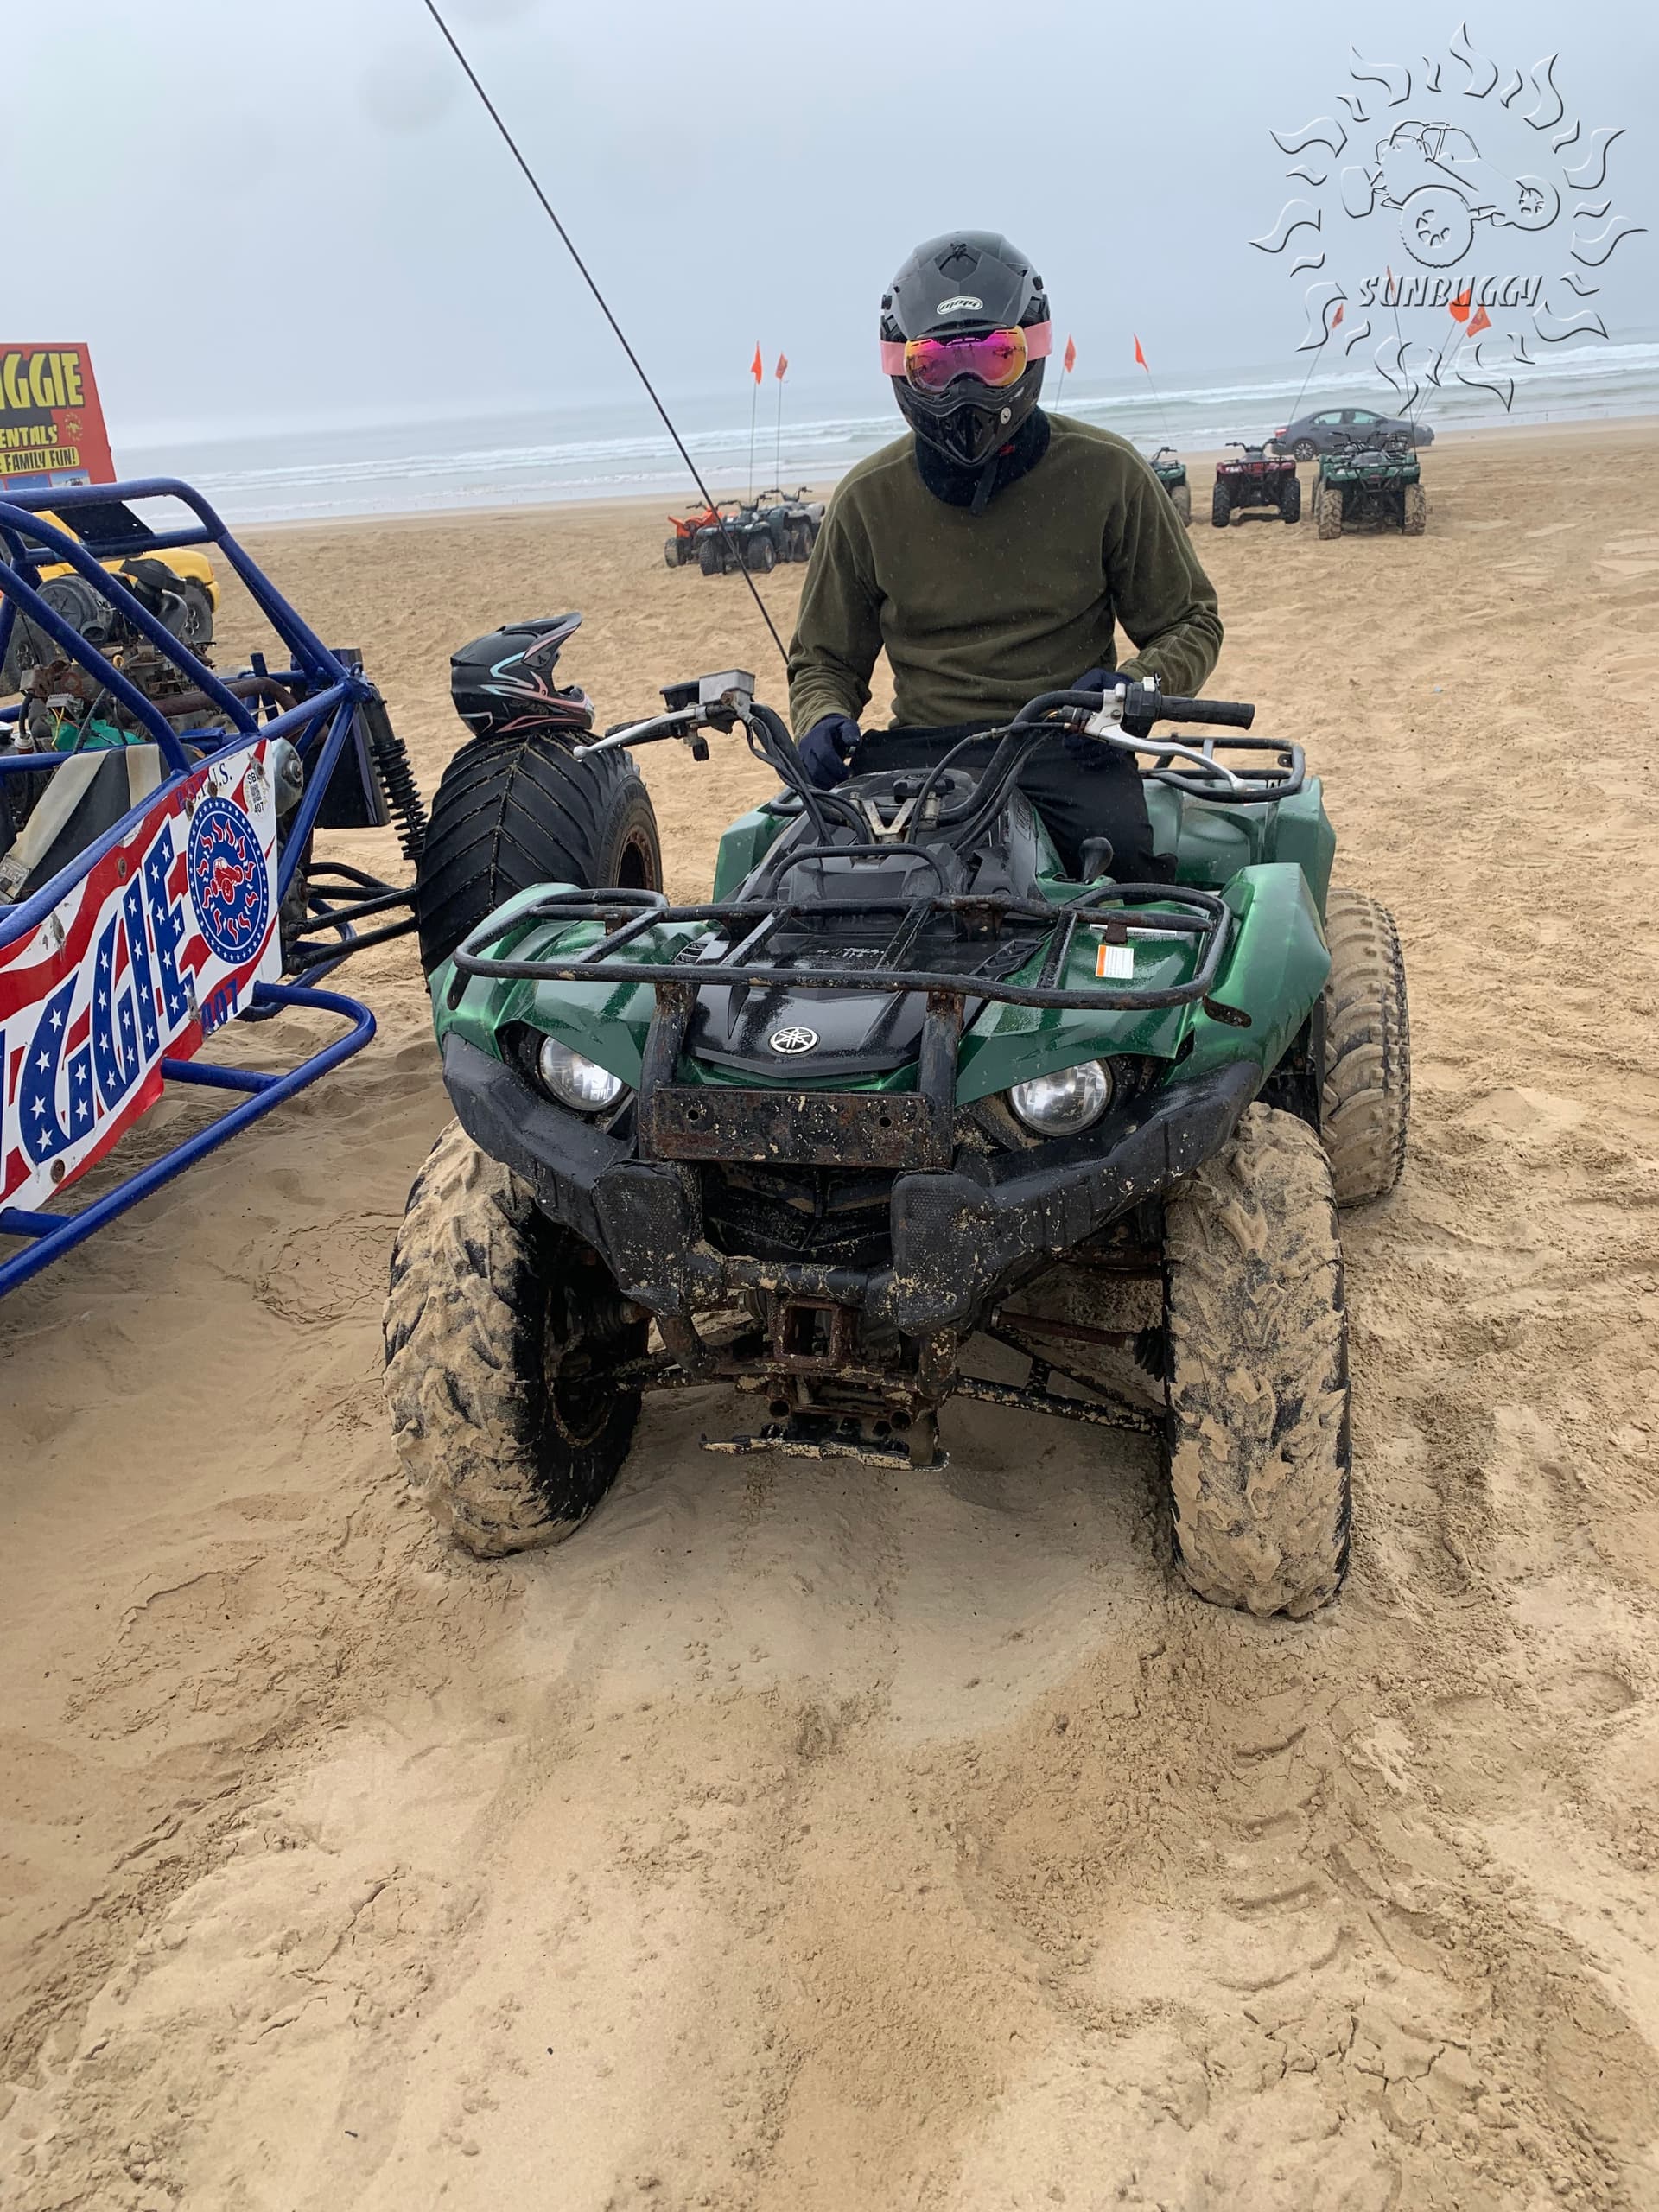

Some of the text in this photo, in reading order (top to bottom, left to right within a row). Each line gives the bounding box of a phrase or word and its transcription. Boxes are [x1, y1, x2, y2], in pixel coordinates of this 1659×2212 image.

[0, 353, 84, 410] GGIE
[5, 451, 45, 472] FAMILY
[49, 448, 76, 467] FUN!
[0, 821, 195, 1192] GGIE
